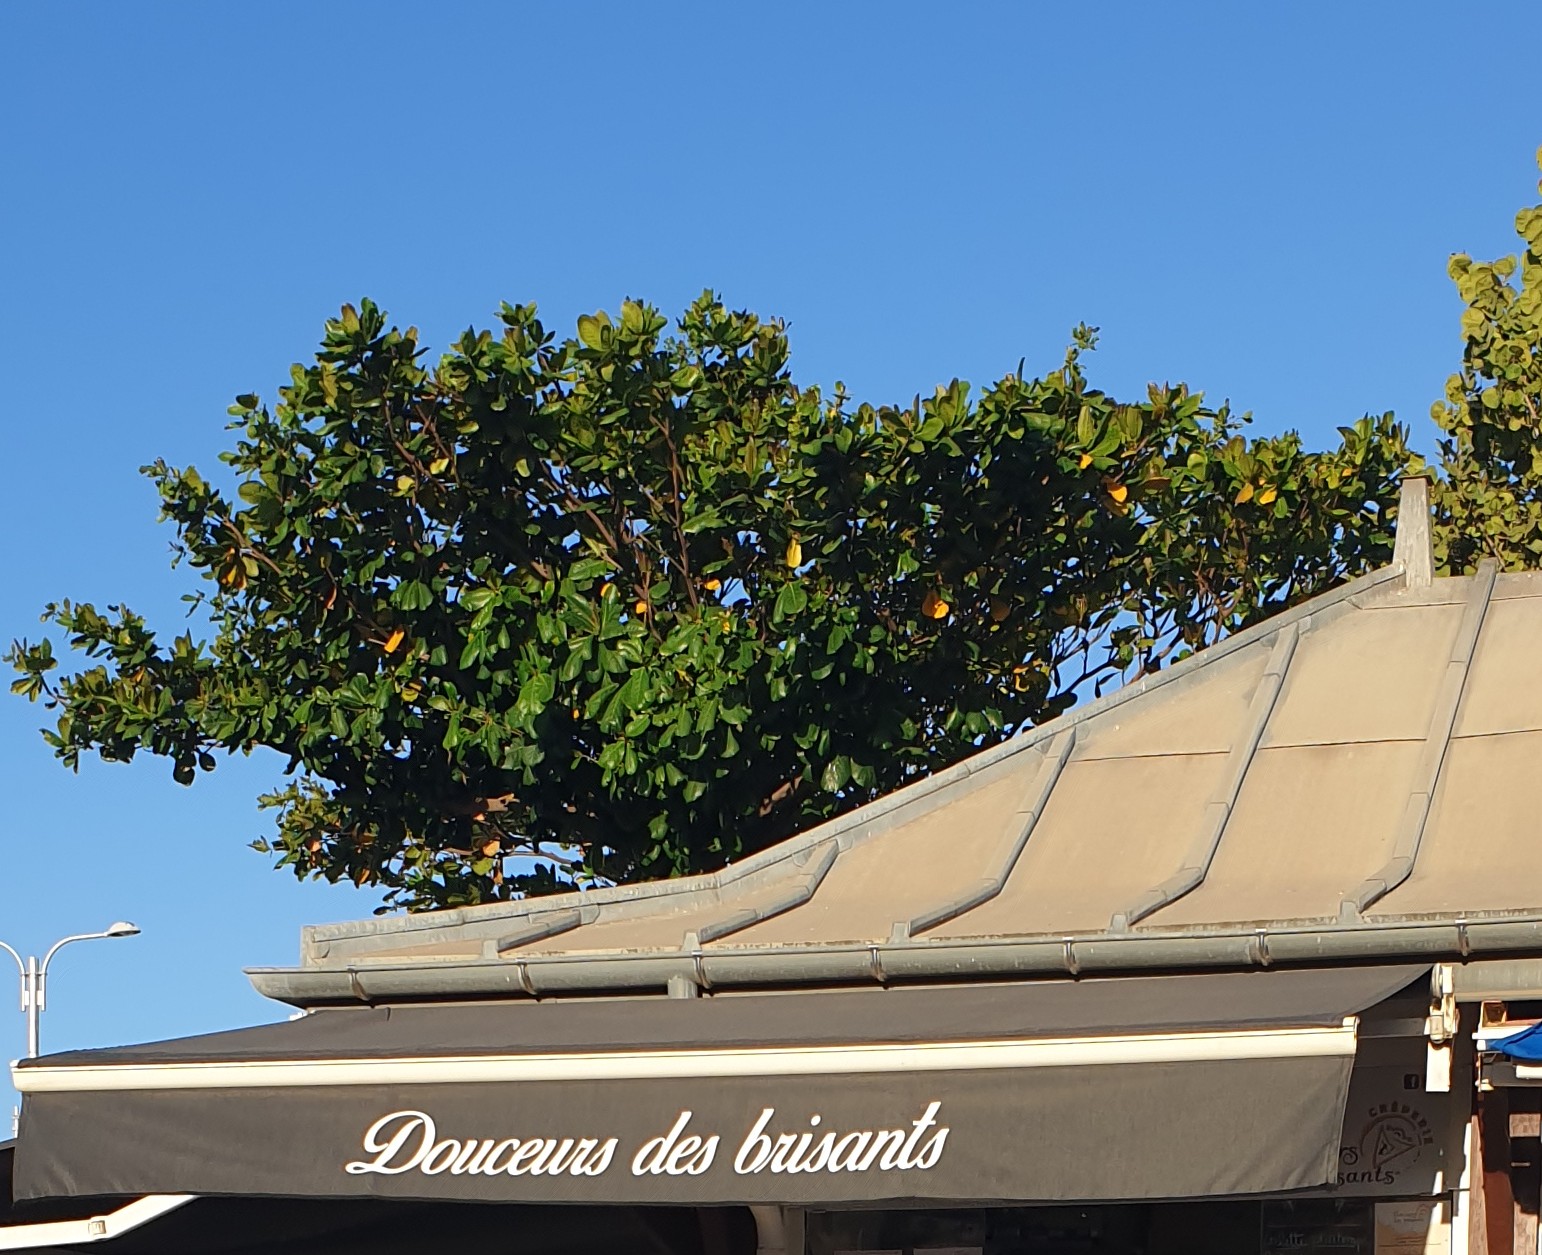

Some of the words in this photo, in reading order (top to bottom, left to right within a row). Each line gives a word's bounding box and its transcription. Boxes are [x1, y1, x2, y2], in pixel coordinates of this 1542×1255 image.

[345, 1110, 619, 1176] Douceurs
[631, 1111, 720, 1176] des
[733, 1101, 949, 1174] brisants
